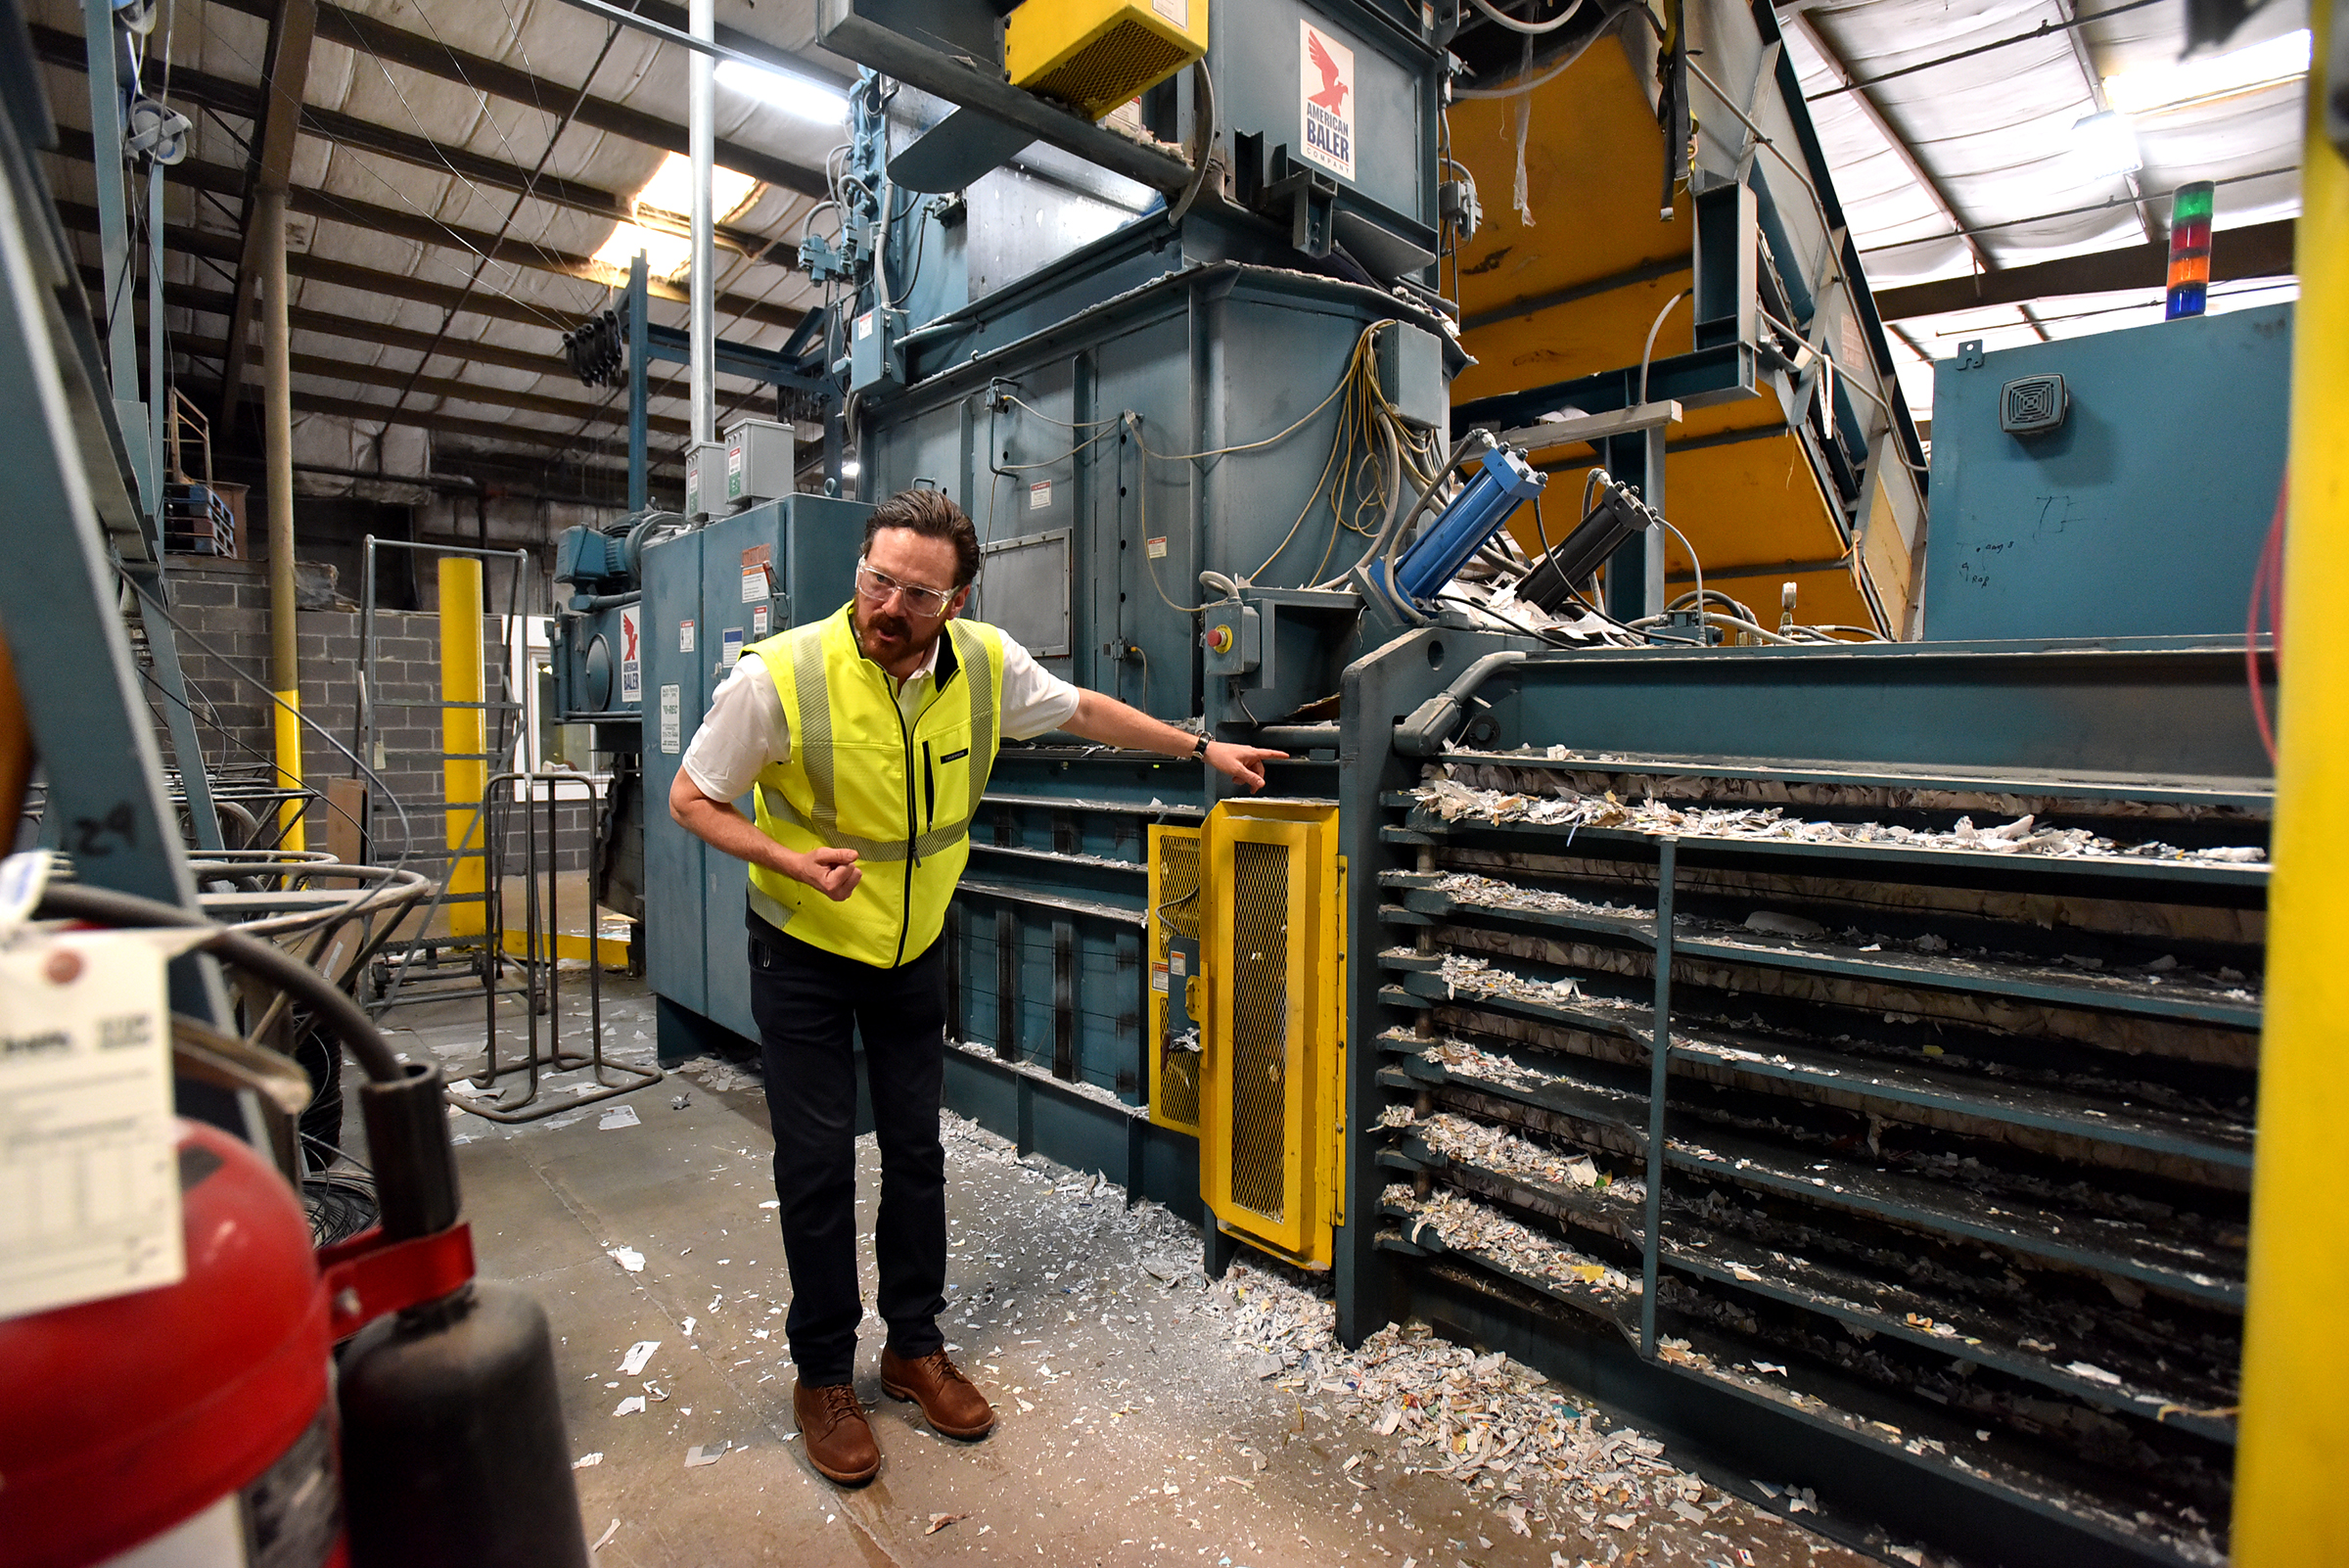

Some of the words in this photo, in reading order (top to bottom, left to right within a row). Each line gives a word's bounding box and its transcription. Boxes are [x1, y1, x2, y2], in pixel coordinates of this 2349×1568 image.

[1307, 102, 1349, 137] AMERICAN
[1307, 117, 1350, 162] BALER
[1307, 147, 1349, 173] COMPANY
[623, 672, 639, 690] BALER
